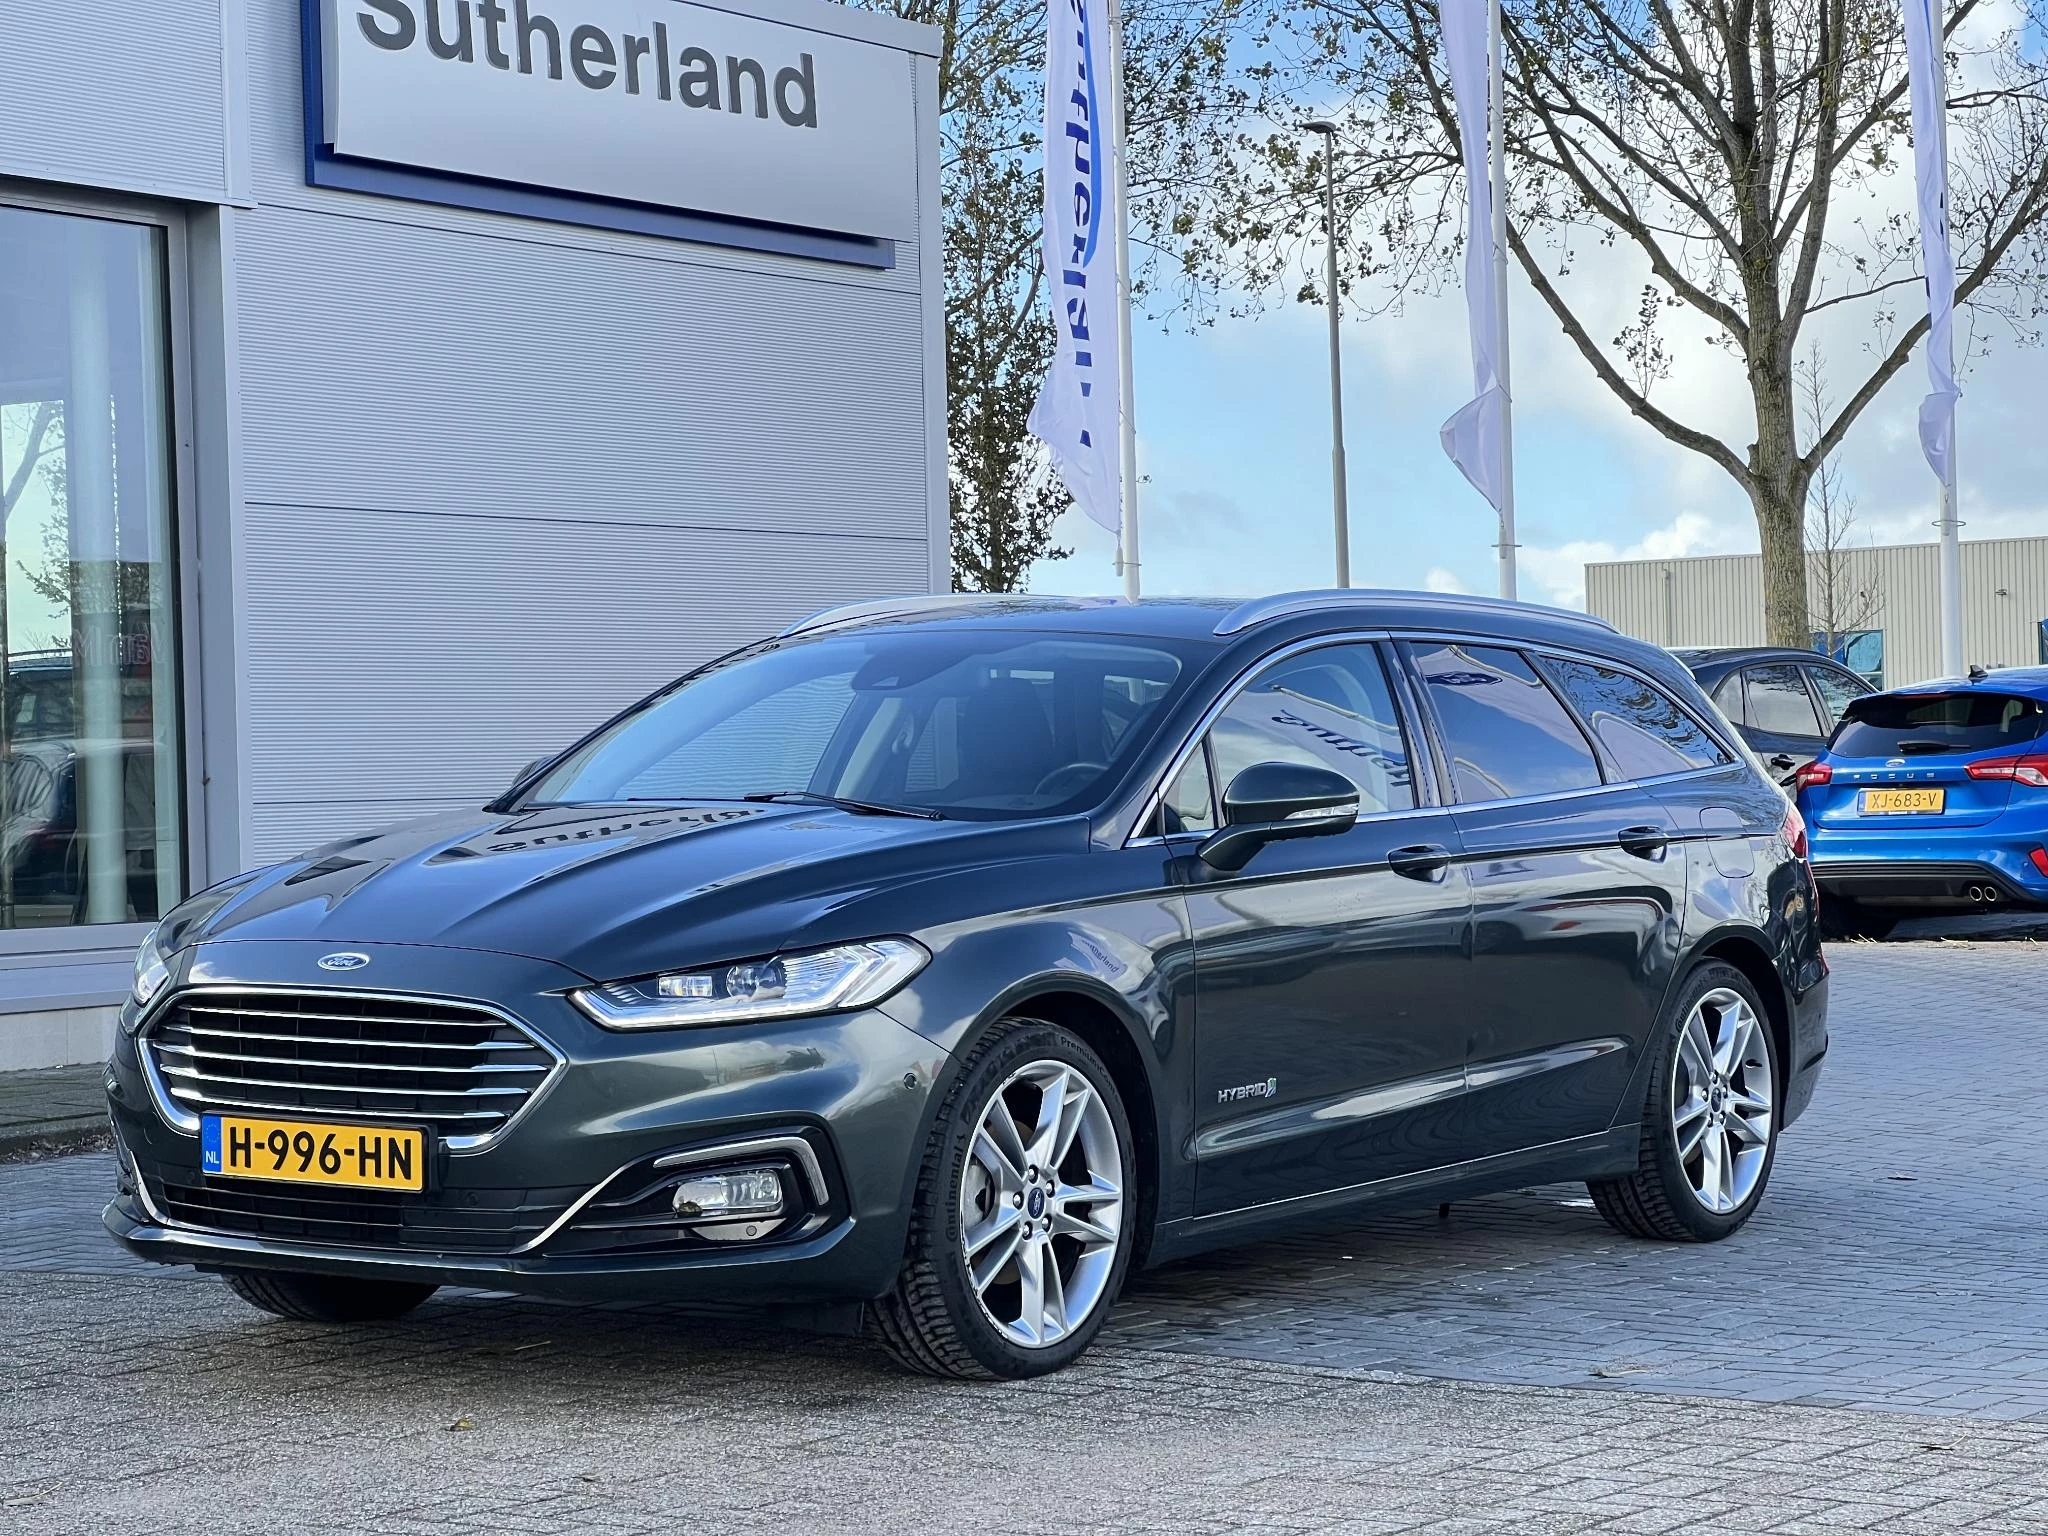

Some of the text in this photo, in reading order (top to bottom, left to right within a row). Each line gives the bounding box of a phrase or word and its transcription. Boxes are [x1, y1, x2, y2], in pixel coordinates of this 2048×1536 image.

[356, 0, 818, 128] Sutherland
[1871, 792, 1937, 809] XJ-683-V
[1218, 1082, 1267, 1103] HYBRID
[205, 1126, 412, 1180] NL H-996-HN
